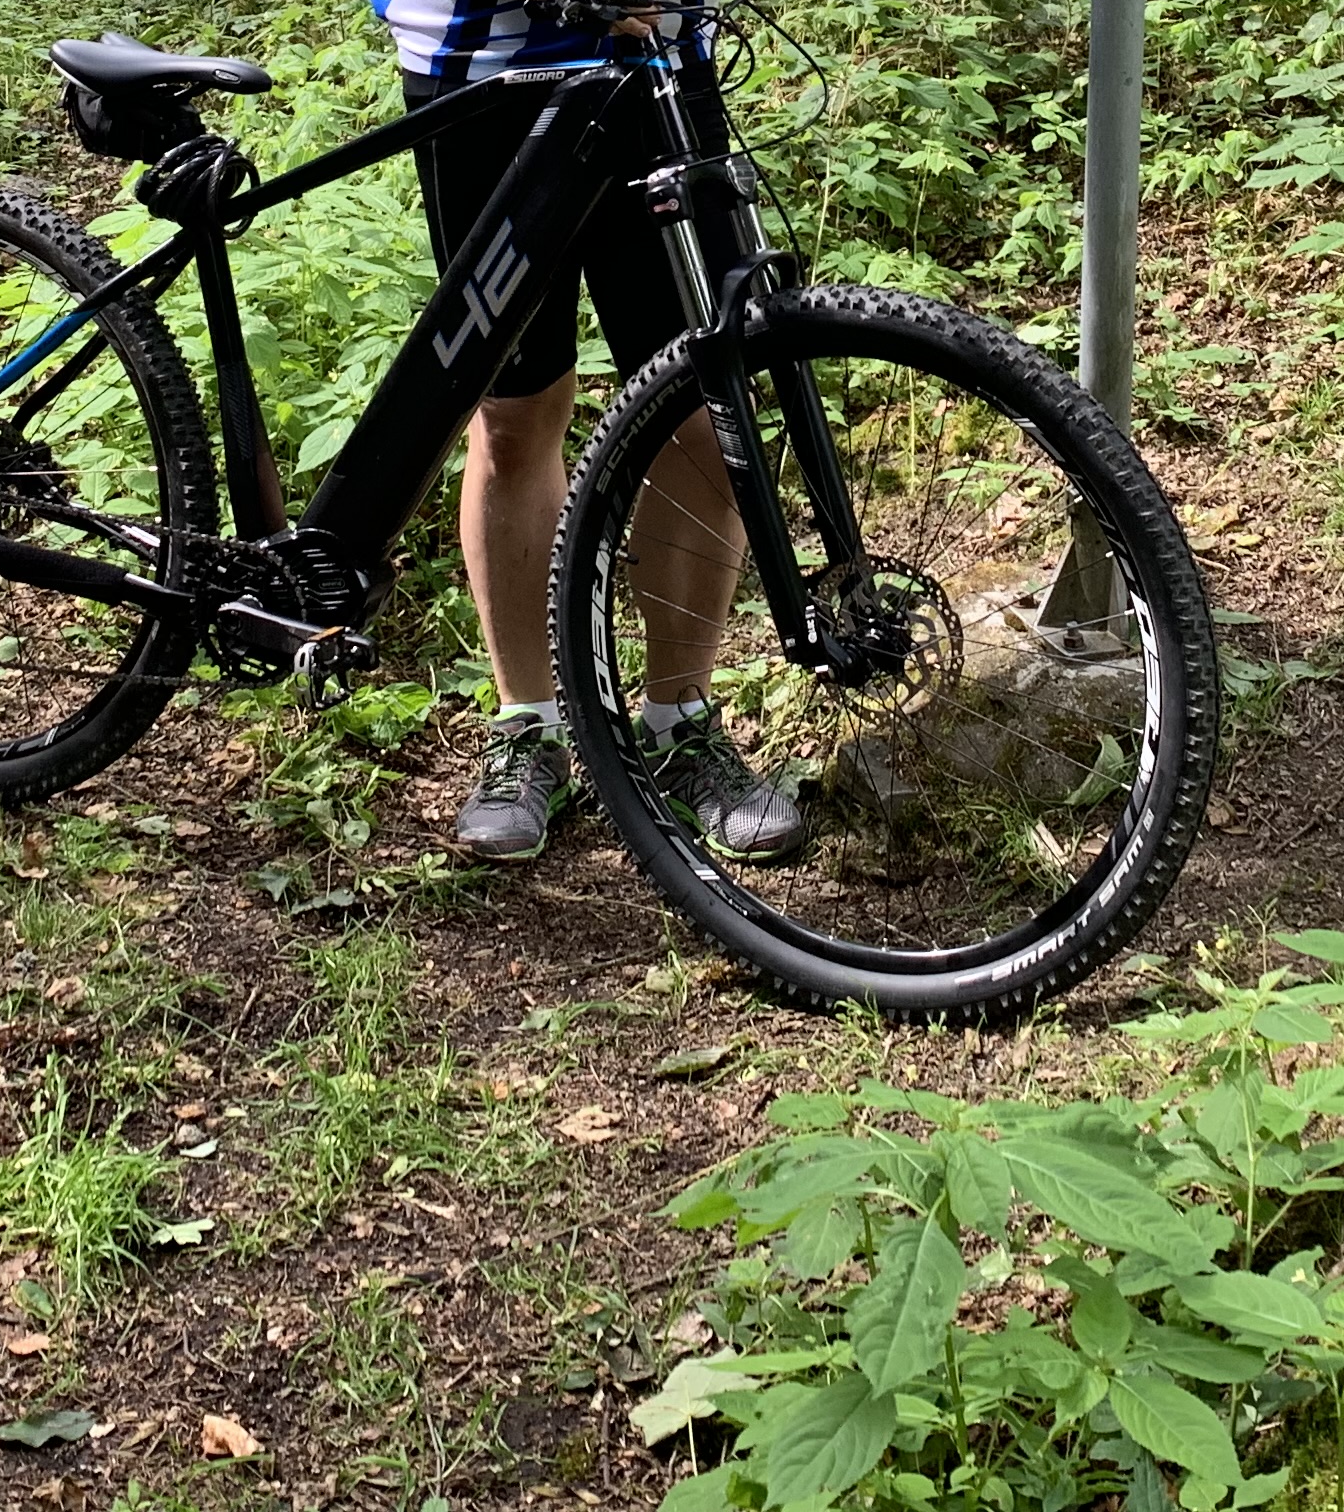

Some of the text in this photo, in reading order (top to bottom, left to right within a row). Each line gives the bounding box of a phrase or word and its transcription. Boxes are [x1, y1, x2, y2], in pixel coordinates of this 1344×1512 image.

[504, 70, 566, 85] ESWORD
[595, 374, 696, 496] SCHWAL
[991, 834, 1144, 982] SMART SAM
